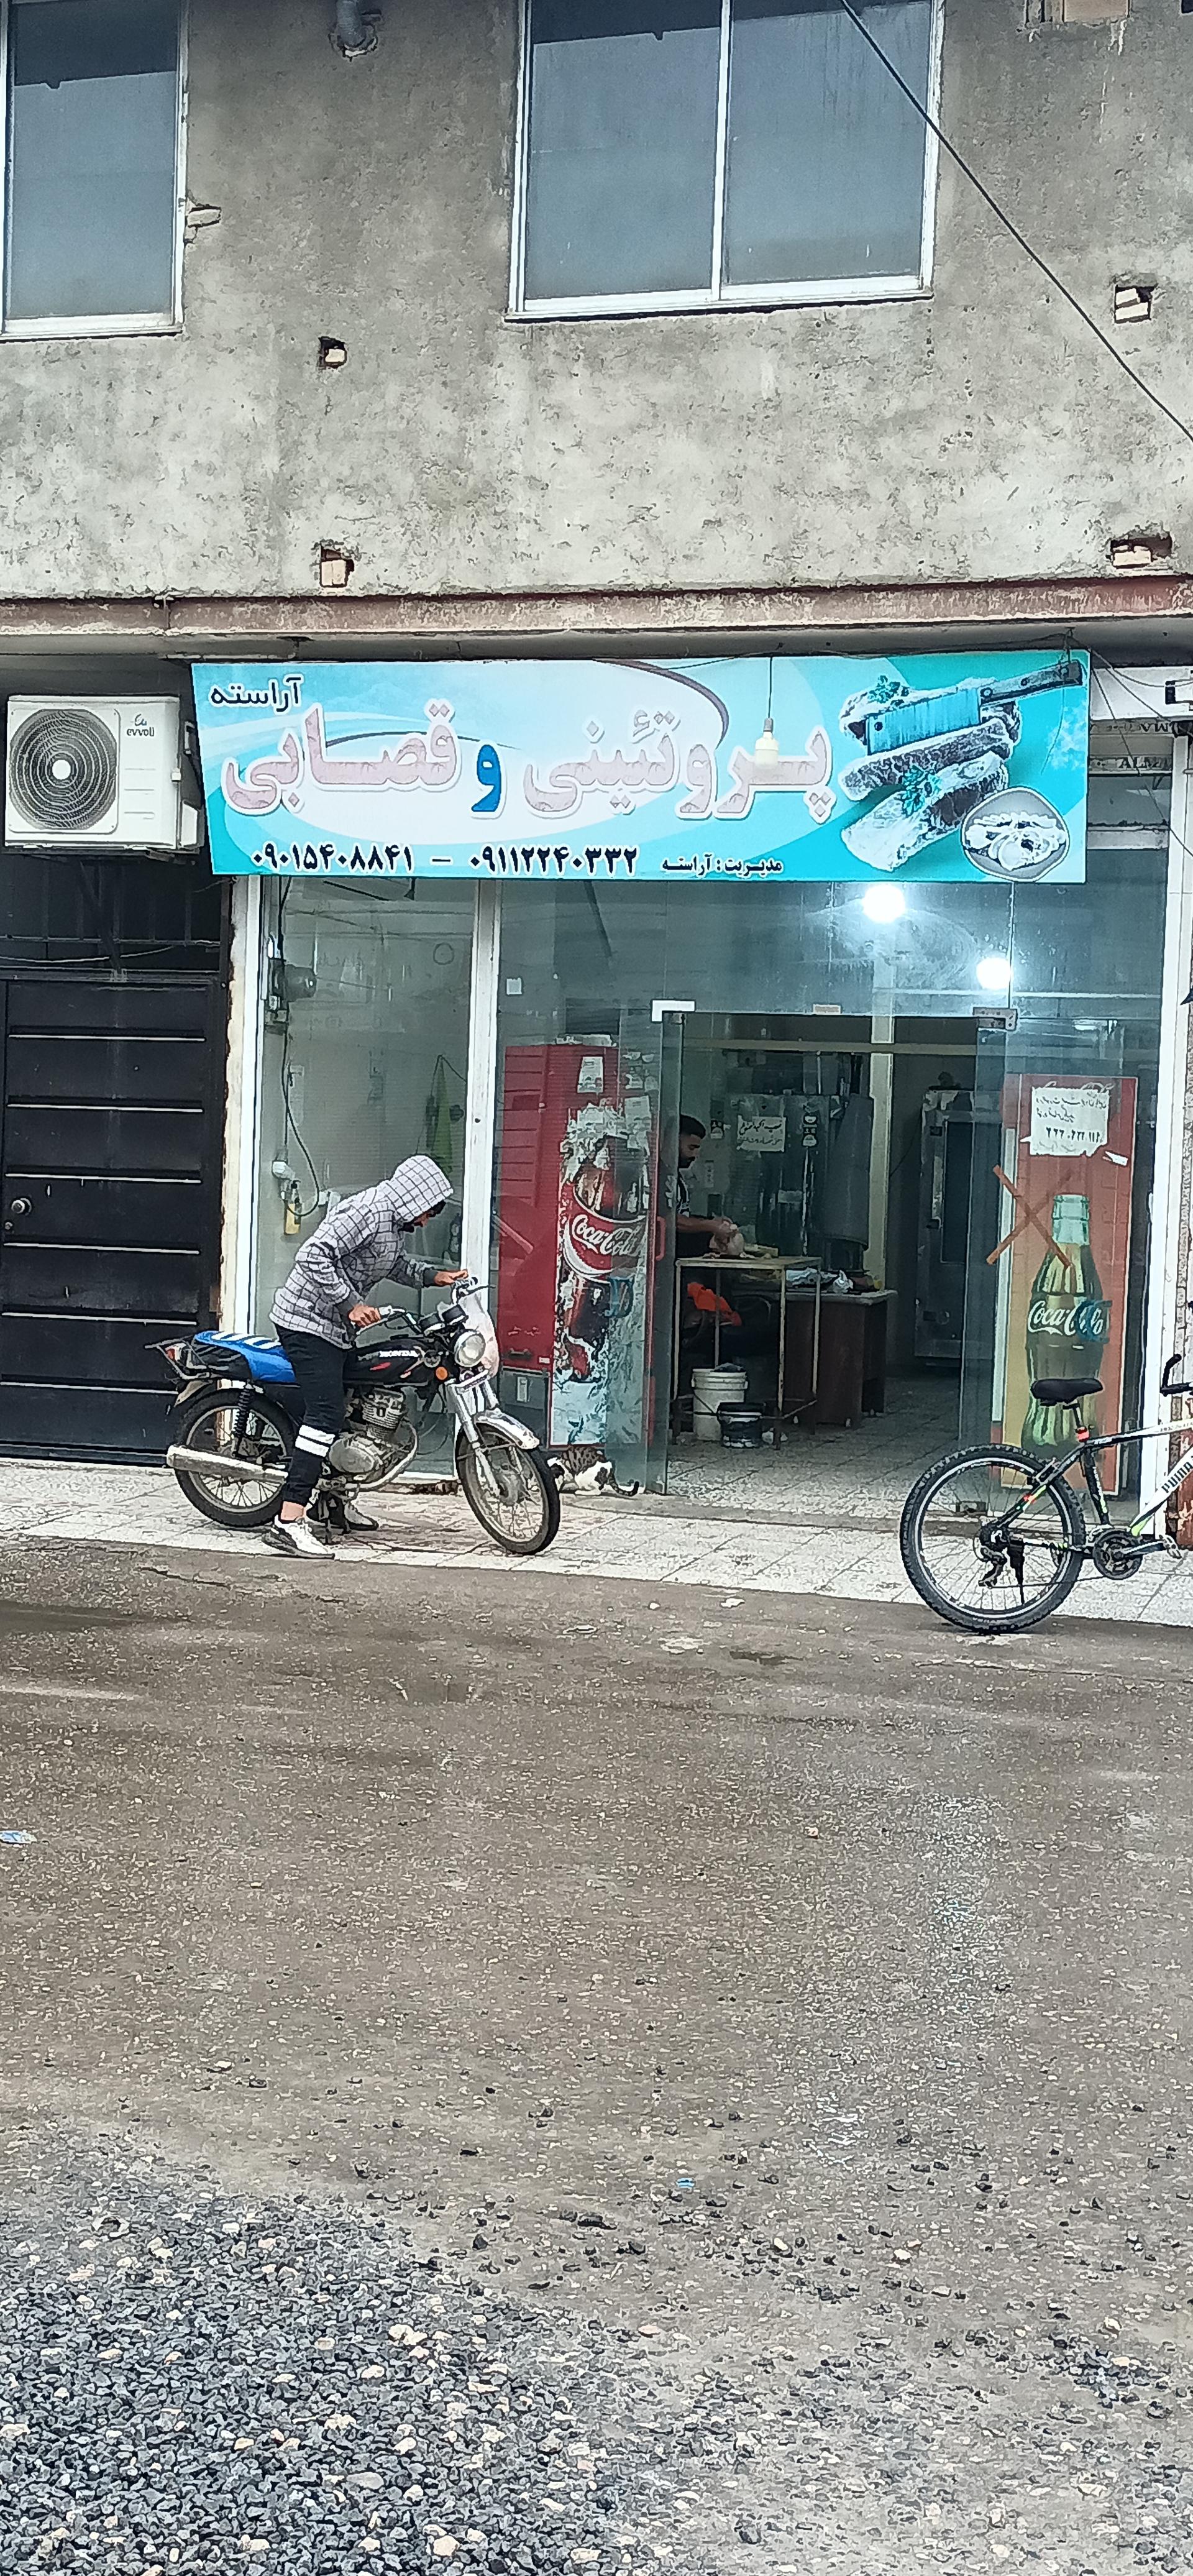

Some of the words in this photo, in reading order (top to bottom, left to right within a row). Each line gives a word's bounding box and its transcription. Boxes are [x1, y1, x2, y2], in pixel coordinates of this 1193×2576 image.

[209, 677, 302, 712] آراسته
[224, 703, 457, 812] قصابی
[471, 745, 502, 812] و
[254, 843, 411, 871] ۰۹۰۱۵۴۰۸۸۴۱
[470, 846, 638, 873] ۰۹۱۱۲۲۴۰۳۳۲
[662, 854, 713, 876] آراسته
